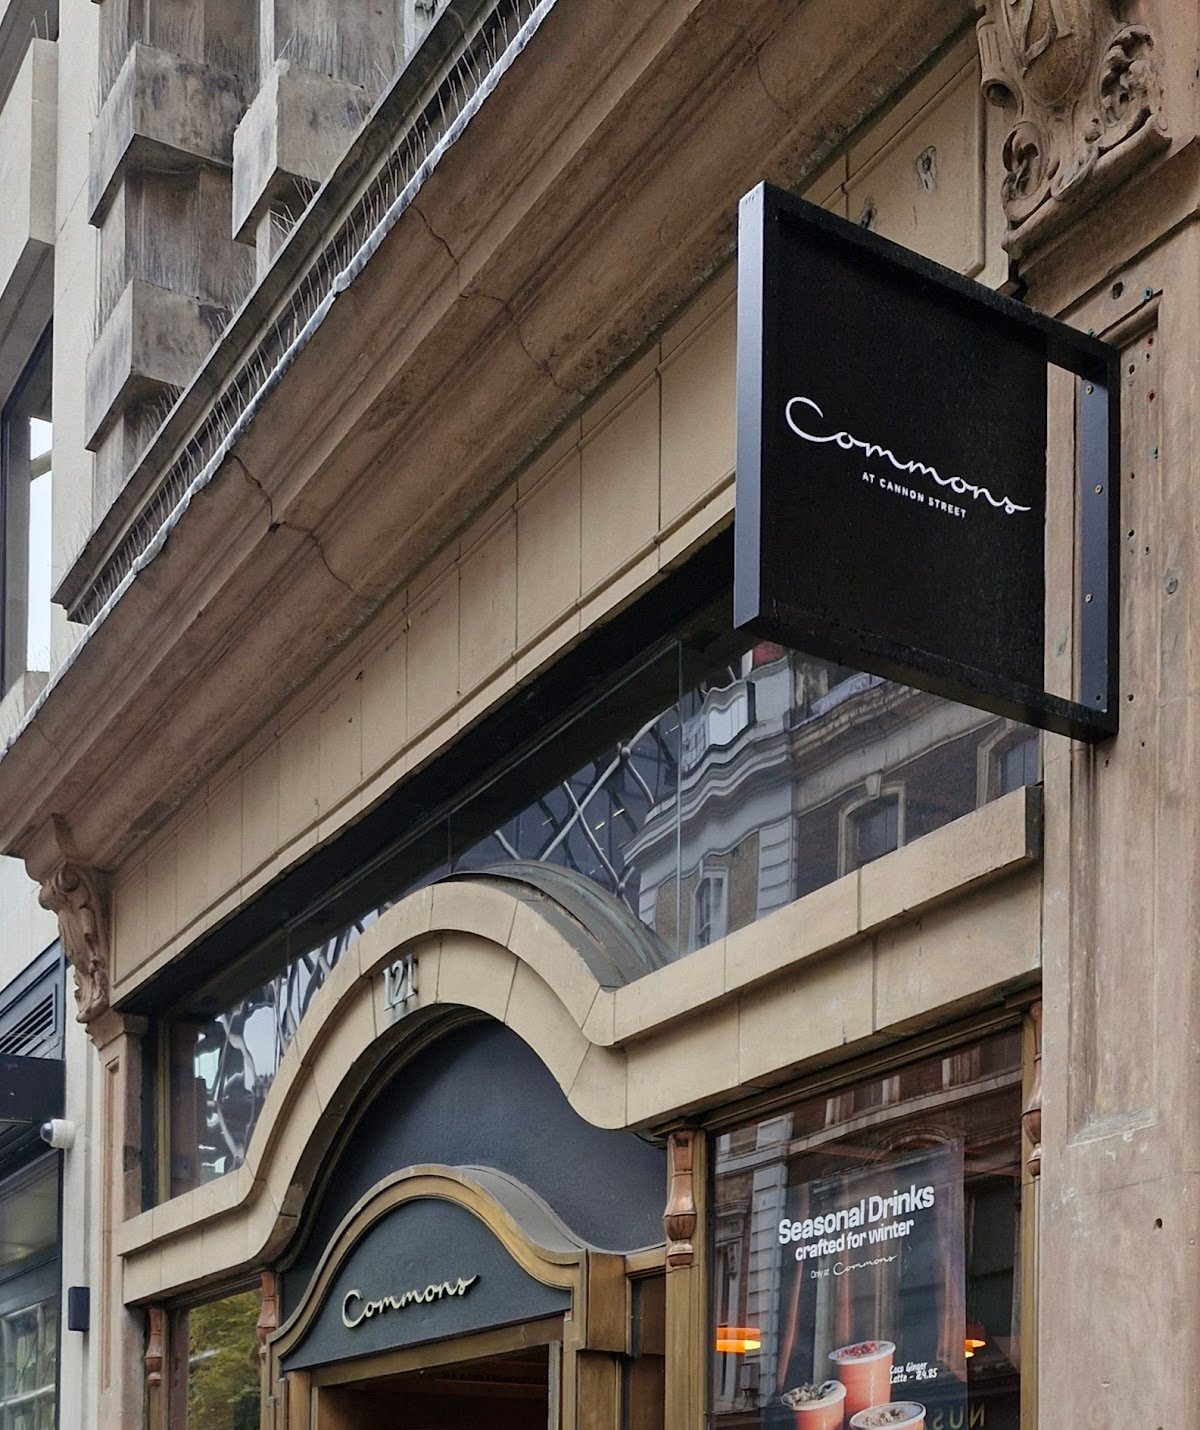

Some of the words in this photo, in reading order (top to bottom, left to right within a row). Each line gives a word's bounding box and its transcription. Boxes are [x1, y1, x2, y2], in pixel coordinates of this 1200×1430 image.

[785, 396, 1032, 515] Commons
[862, 471, 875, 484] AT
[879, 478, 925, 503] CANNON
[928, 496, 967, 519] STREET
[382, 953, 416, 1012] 121
[778, 1199, 865, 1245] Seasonal
[868, 1184, 935, 1223] Drinks
[794, 1233, 845, 1262] crafted
[847, 1230, 867, 1250] for
[868, 1219, 915, 1244] winter
[833, 1254, 898, 1276] Commons
[342, 1274, 479, 1328] Commons
[890, 1373, 908, 1385] Latte
